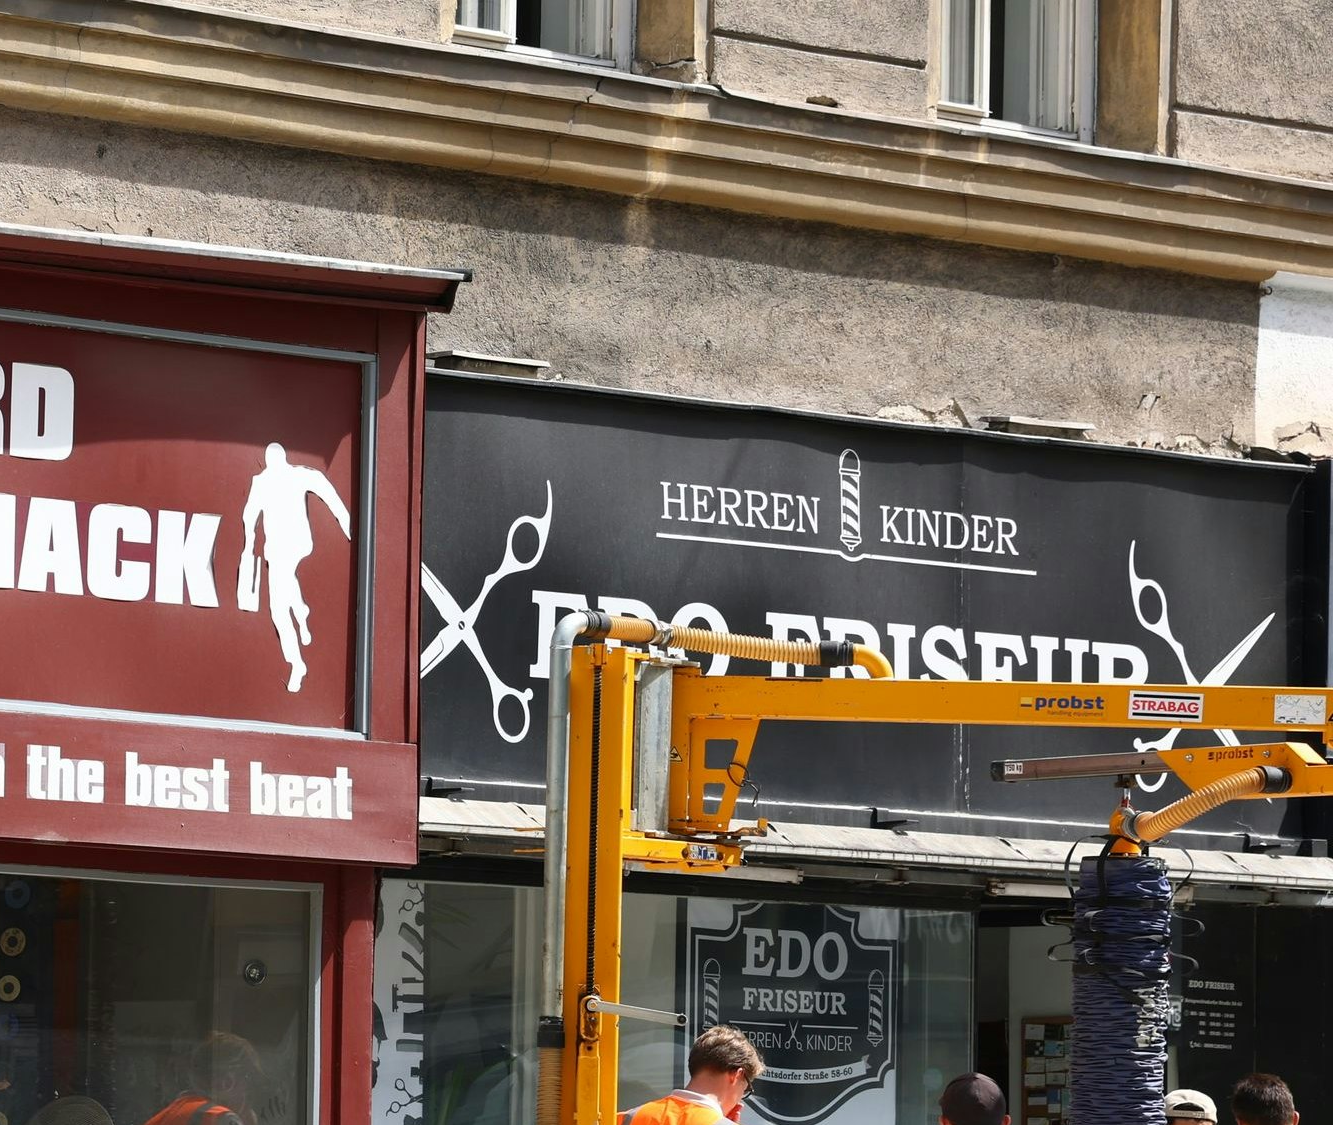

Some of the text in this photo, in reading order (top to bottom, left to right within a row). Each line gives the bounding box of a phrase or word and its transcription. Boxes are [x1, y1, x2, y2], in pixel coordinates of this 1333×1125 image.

[660, 481, 1020, 556] HERREN KINDER
[1035, 696, 1199, 714] probst STRABAG
[1215, 746, 1254, 762] probst
[27, 745, 105, 804] the
[126, 752, 229, 813] best
[250, 761, 353, 821] beat
[741, 927, 849, 981] EDO
[742, 987, 847, 1016] FRISEUR
[742, 1031, 852, 1052] RREN KINDER
[803, 1071, 829, 1081] Straße
[831, 1066, 853, 1078] 58-60
